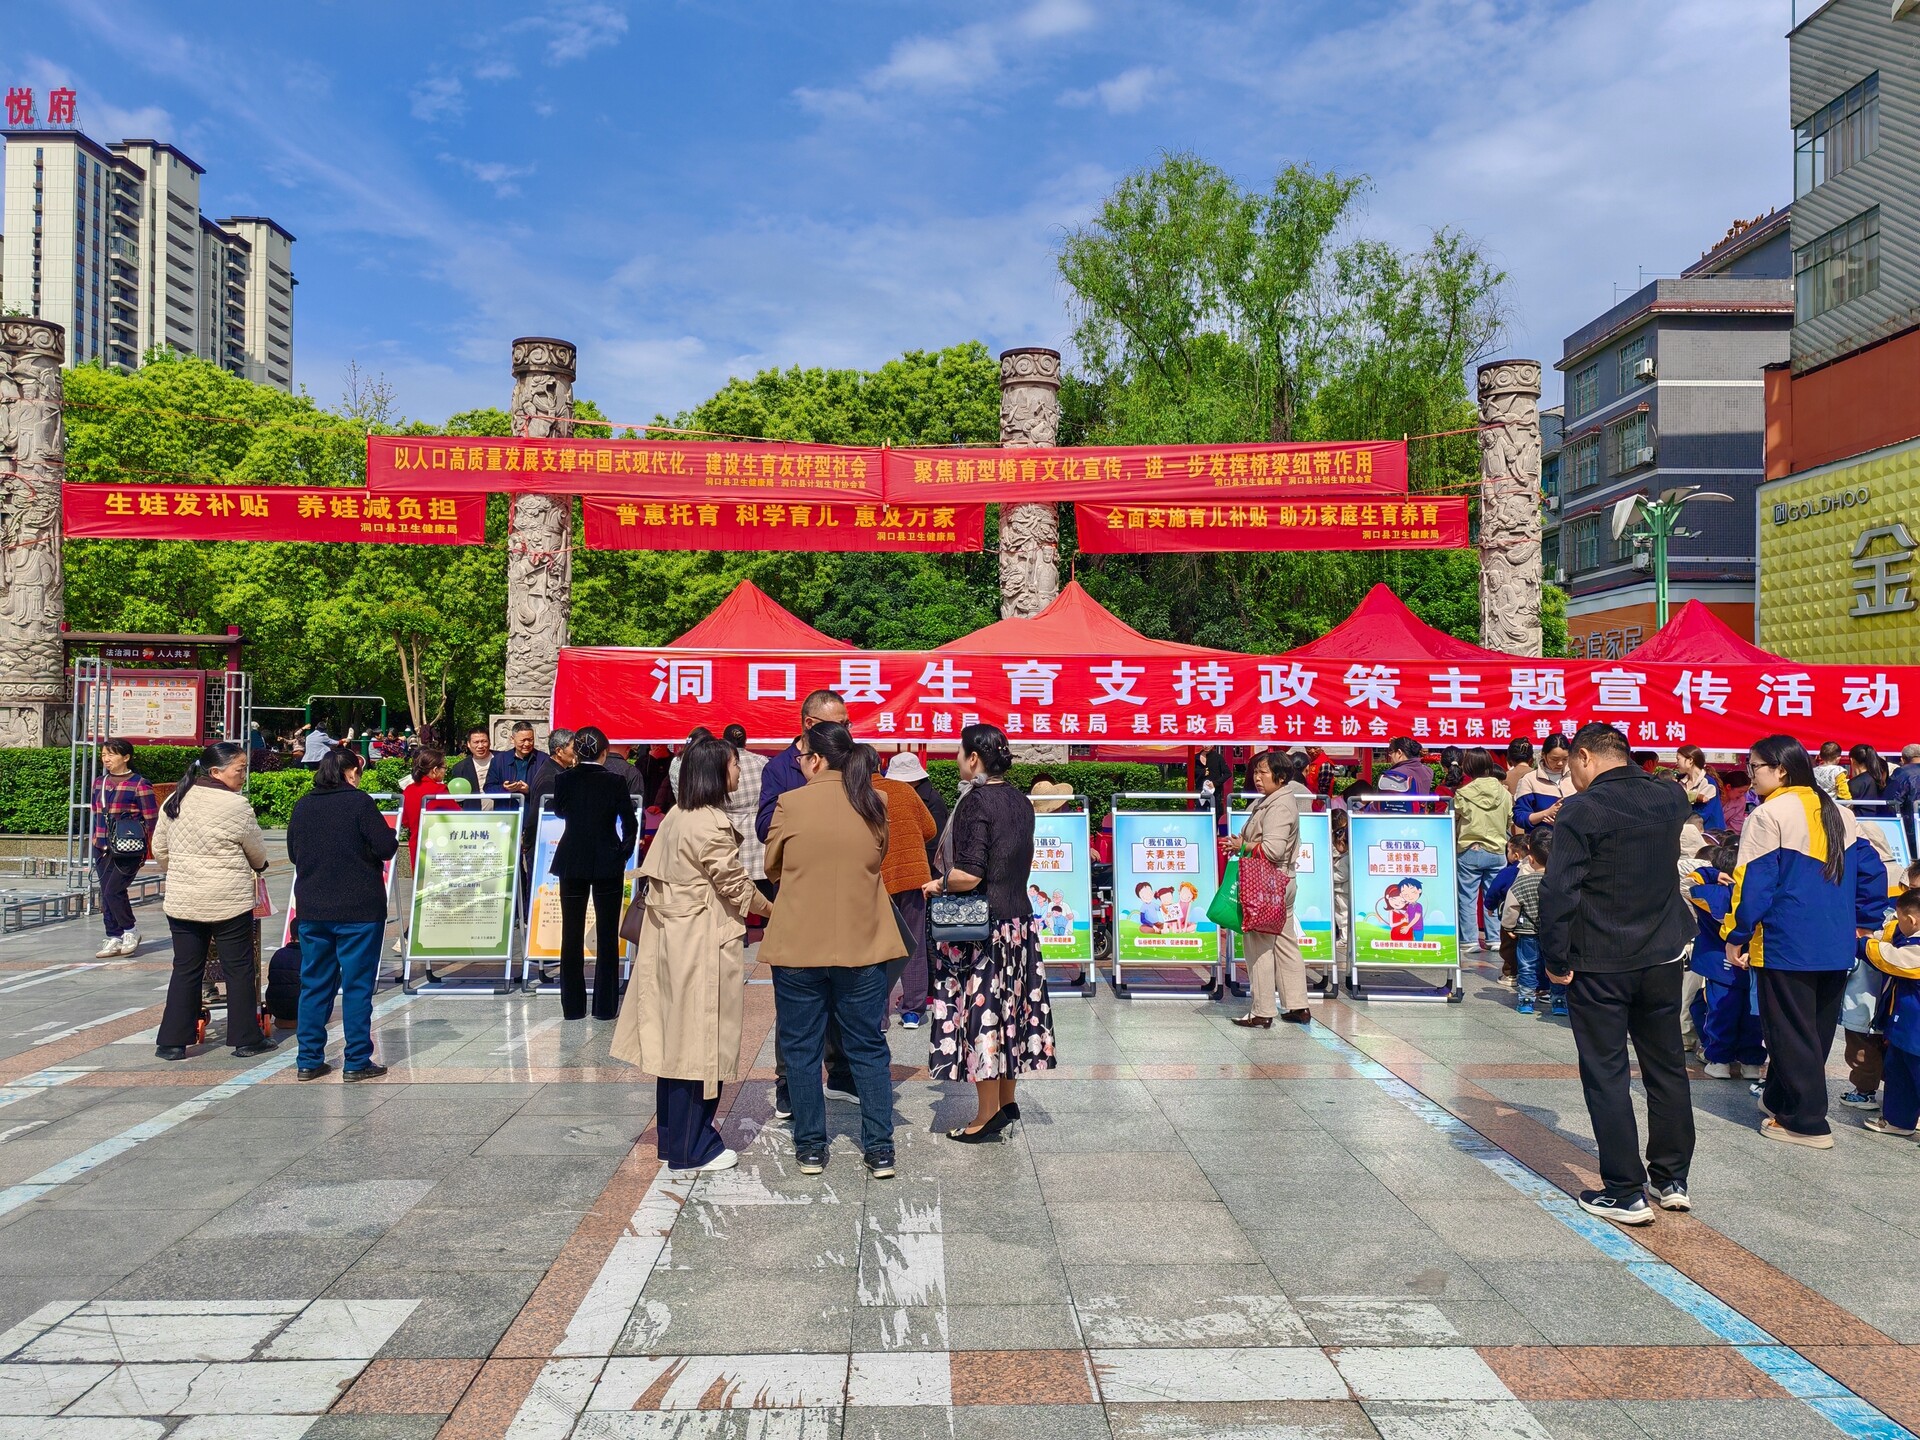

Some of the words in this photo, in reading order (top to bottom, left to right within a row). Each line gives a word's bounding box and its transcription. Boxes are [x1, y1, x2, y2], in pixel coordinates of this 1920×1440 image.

[4, 87, 77, 125] 悦府
[705, 477, 775, 487] 洞口县卫生健康局
[1214, 477, 1282, 487] 洞口县卫生健康局
[105, 492, 270, 518] 生娃发补贴
[297, 495, 458, 521] 养娃减负担
[1787, 487, 1870, 521] GOLDHOO
[616, 504, 719, 527] 普惠托育
[735, 504, 840, 528] 科学育儿
[854, 505, 956, 528] 惠及万家
[1107, 505, 1268, 529] 全面实施育儿补贴
[1280, 504, 1439, 527] 助力家庭生育养育
[360, 522, 458, 535] 洞口县卫生健康局
[876, 531, 956, 542] 洞口县卫生健康局
[1362, 529, 1439, 540] 洞口县卫生健康局
[105, 649, 140, 657] 法治洞口
[157, 649, 191, 658] 人人共享
[650, 657, 1900, 719] 洞口县生育支持政策主题宣传活动
[1004, 713, 1108, 734] 县医保局
[1131, 714, 1235, 735] 县民政局
[1257, 714, 1389, 737] 县计生协会
[1411, 717, 1511, 738] 县妇保院
[1533, 719, 1686, 741] 普惠育机构
[449, 830, 490, 840] 育儿补贴
[1148, 838, 1182, 846] 我们倡议
[1385, 841, 1420, 850] 我们倡议
[1145, 849, 1186, 859] 夫妻共担
[1031, 859, 1060, 869] 会价值
[1145, 860, 1187, 871] 育儿责任
